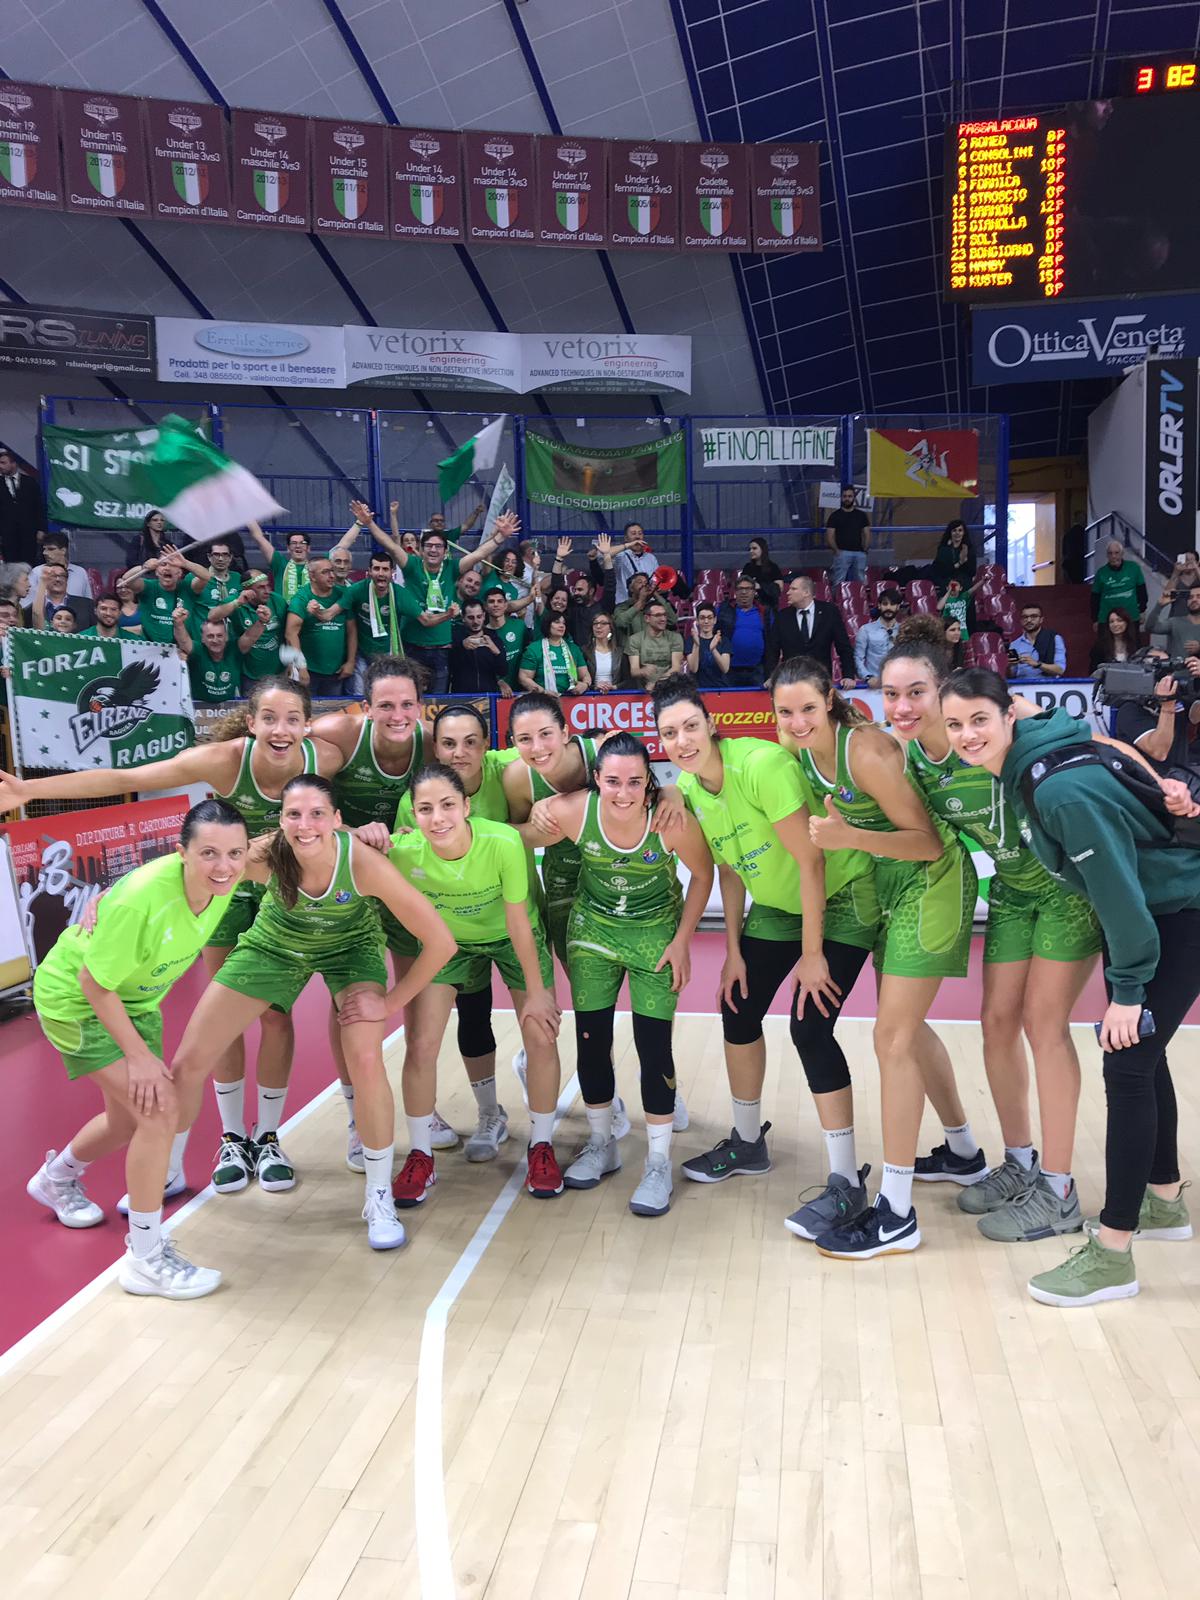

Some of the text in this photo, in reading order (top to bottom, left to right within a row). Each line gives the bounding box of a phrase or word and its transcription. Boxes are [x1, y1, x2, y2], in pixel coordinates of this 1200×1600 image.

[1137, 64, 1196, 90] 3 82
[0, 120, 35, 130] nder 19
[959, 118, 1038, 136] PASSALACQUA
[80, 128, 122, 141] Under 15
[80, 139, 128, 153] femminile
[166, 138, 205, 151] Under 13
[959, 138, 968, 150] 3
[969, 135, 1007, 149] ROMEO
[155, 147, 220, 162] femminile 3vs3
[250, 147, 289, 160] Under 14
[958, 152, 967, 164] 4
[970, 146, 1034, 162] CONSOLINI
[241, 157, 300, 171] maschile 3vs3
[329, 155, 367, 168] Under 15
[406, 162, 443, 174] Under 14
[331, 167, 368, 178] maschile
[481, 166, 517, 177] Under 14
[969, 162, 1012, 176] CIMILI
[395, 172, 456, 184] femminile 3vs3
[473, 177, 528, 187] maschile 3vs3
[553, 171, 588, 181] Under 17
[625, 174, 660, 185] Under 14
[699, 177, 728, 187] Cadette
[772, 178, 797, 187] Allieve
[552, 180, 591, 191] femminile
[614, 183, 673, 194] femminile 3vs3
[969, 176, 1021, 191] FORMICA
[27, 189, 56, 201] d'Italia
[695, 186, 734, 196] femminile
[757, 186, 814, 196] femminile 3vs3
[952, 194, 965, 206] 11
[969, 188, 1028, 205] STROSCIO
[71, 194, 145, 210] Campioni d'Italia
[158, 203, 228, 218] Campioni d'Italia
[237, 209, 305, 225] Campioni d'Italia
[952, 208, 967, 220] 12
[969, 204, 1013, 219] HARMON
[317, 217, 384, 232] Campioni d'Italia
[395, 223, 459, 236] Campioni d'Italia
[952, 222, 966, 234] 15
[472, 227, 534, 239] Campioni d'Italia
[541, 230, 603, 242] Campioni d'Italia
[612, 234, 674, 245] Campioni d'Italia
[951, 235, 966, 247] 17
[969, 232, 998, 246] SOLI
[685, 236, 747, 247] Campioni d'Italia
[757, 236, 818, 247] Campioni d'Italia
[951, 248, 966, 261] 23
[969, 243, 1034, 260] BONGIORNO
[951, 262, 966, 274] 25
[951, 276, 966, 288] 30
[969, 272, 1013, 287] KUSTER
[79, 327, 146, 348] TUNING
[259, 335, 304, 349] Service
[366, 331, 467, 354] vetorix
[544, 335, 638, 359] vetorix
[169, 358, 209, 370] Prodotti
[212, 361, 228, 371] per
[231, 362, 240, 370] lo
[243, 363, 268, 373] sport
[280, 363, 285, 372] il
[288, 364, 336, 375] benessere
[430, 355, 487, 367] engineering
[604, 360, 658, 370] engineering
[193, 371, 208, 379] 348
[352, 362, 383, 371] ADVANCED
[384, 364, 420, 373] TECHNIQUES
[428, 365, 480, 375] NON-DESTRUCTIVE
[482, 368, 514, 377] INSPECTION
[530, 369, 559, 377] ADVANCED
[560, 369, 595, 377] TECHNIQUES
[603, 370, 653, 378] NON-DESTRUCTIVE
[654, 370, 685, 378] INSPECTION
[531, 490, 681, 511] #vedosolobiancoverde
[22, 646, 107, 680] FORZA
[72, 704, 151, 750] EIRENE
[109, 722, 134, 736] RAGUSA
[116, 730, 188, 768] RAGUS
[76, 825, 126, 847] DIPINTURE
[129, 824, 136, 836] E
